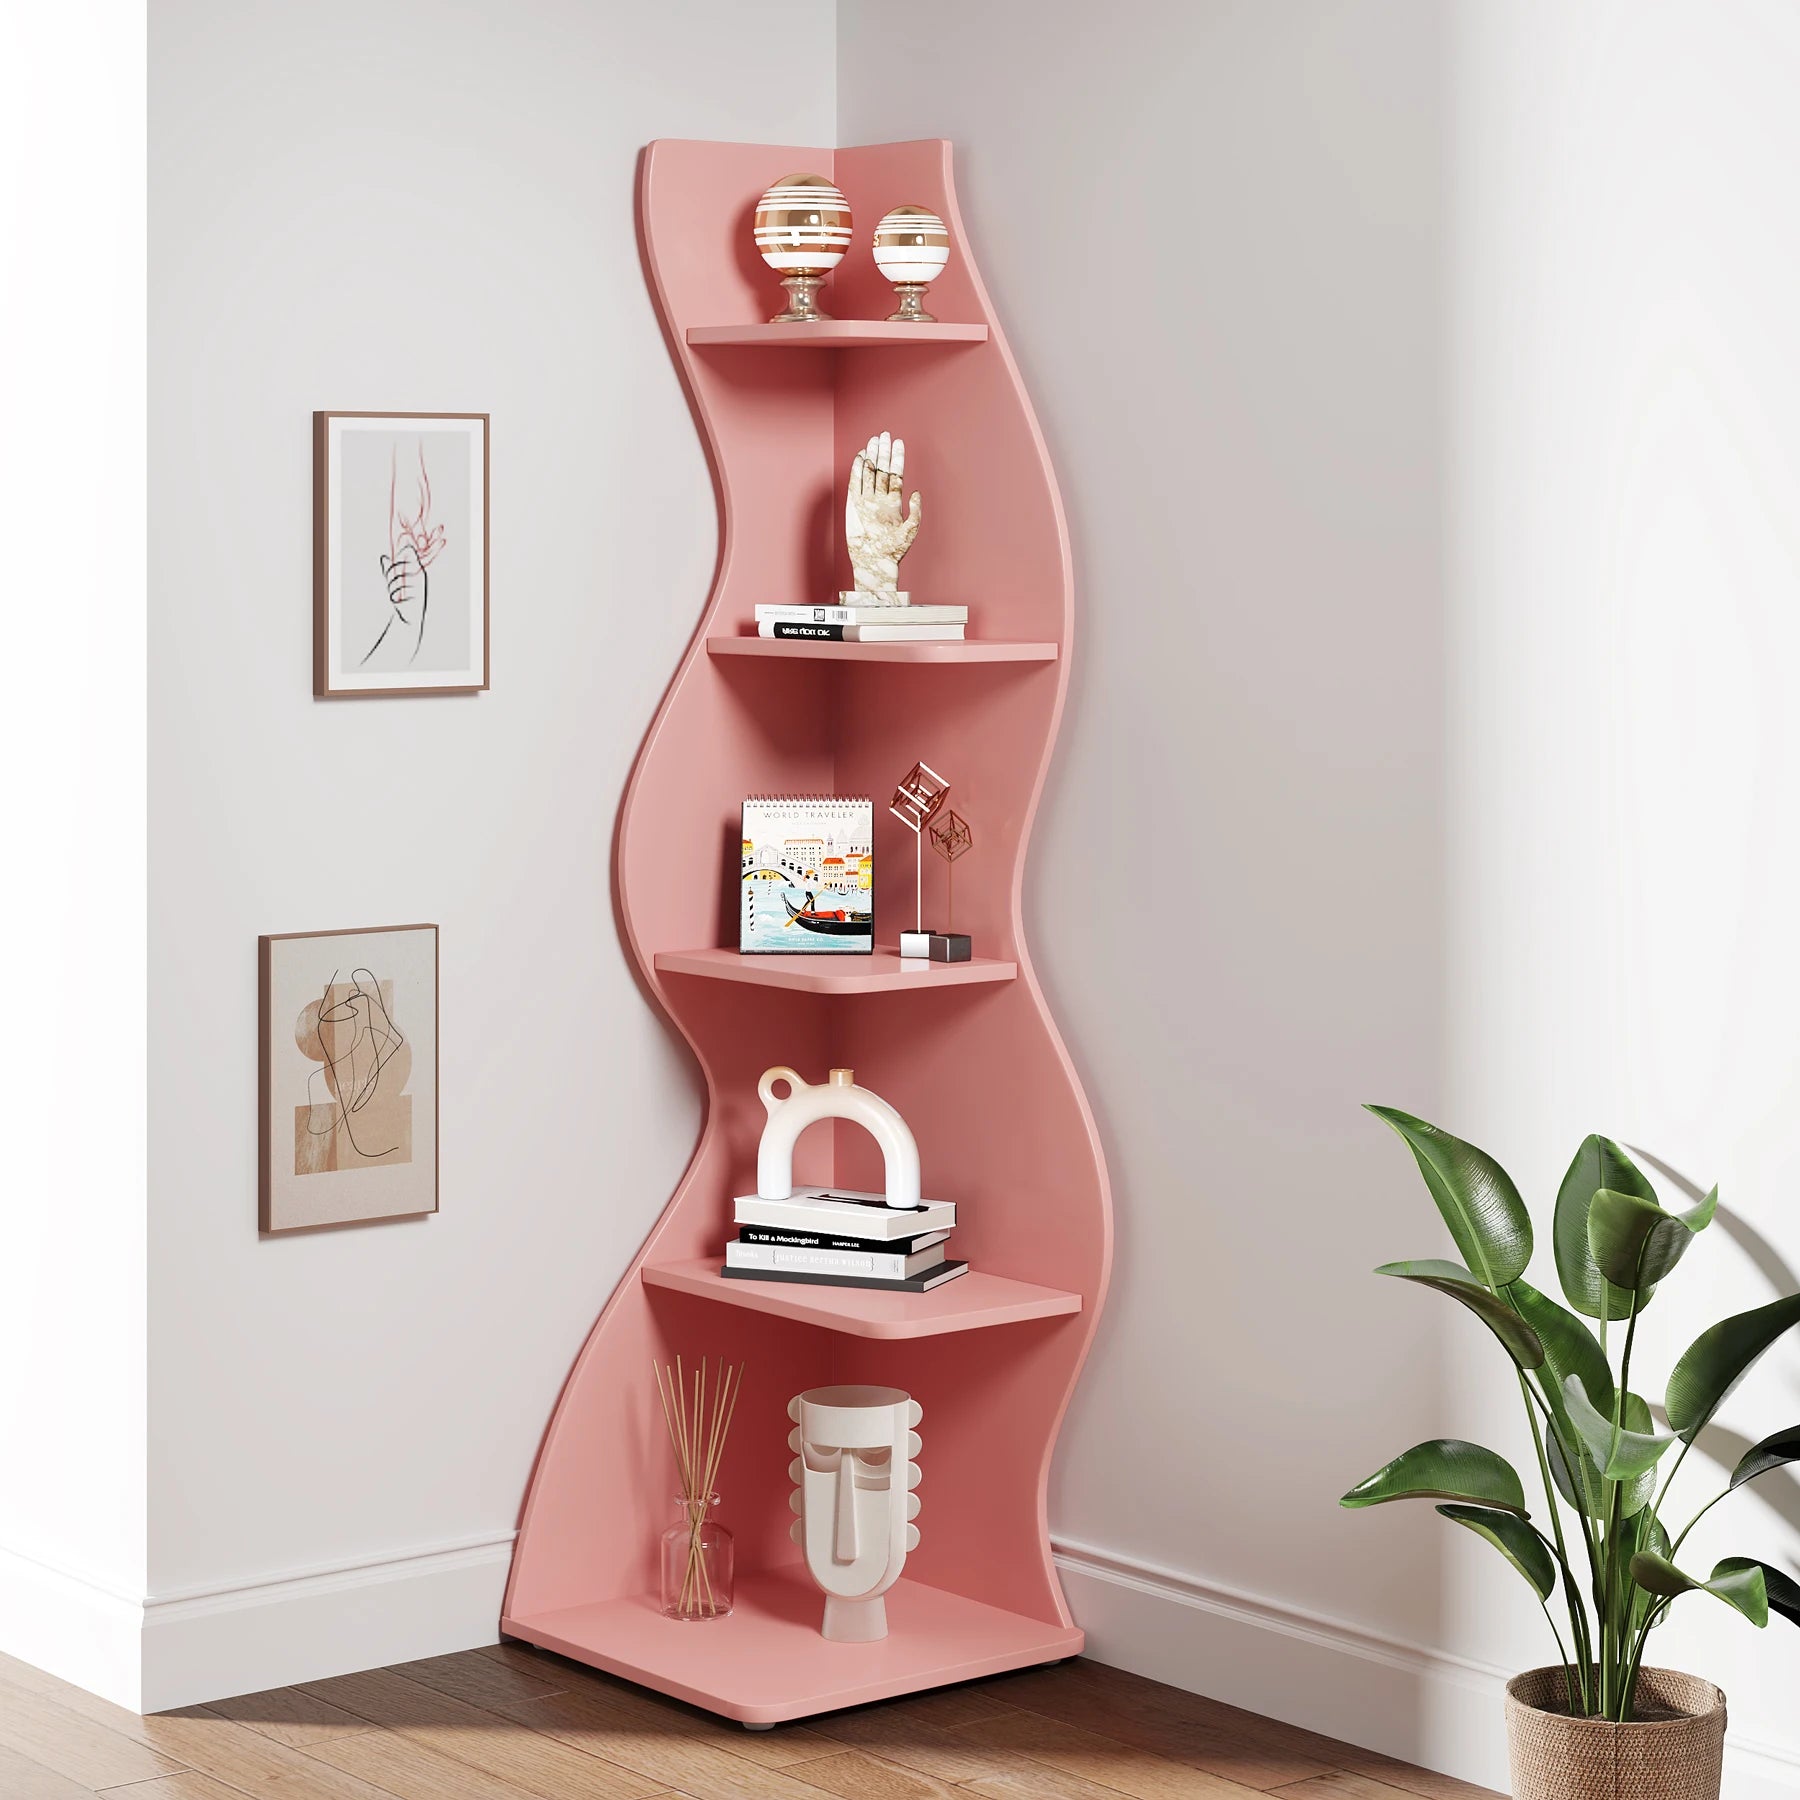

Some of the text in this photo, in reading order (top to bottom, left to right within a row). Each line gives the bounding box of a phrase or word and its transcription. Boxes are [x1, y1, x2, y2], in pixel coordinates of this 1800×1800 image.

[763, 811, 854, 819] WORLD TRAVELER
[776, 1235, 819, 1245] Mockingbird
